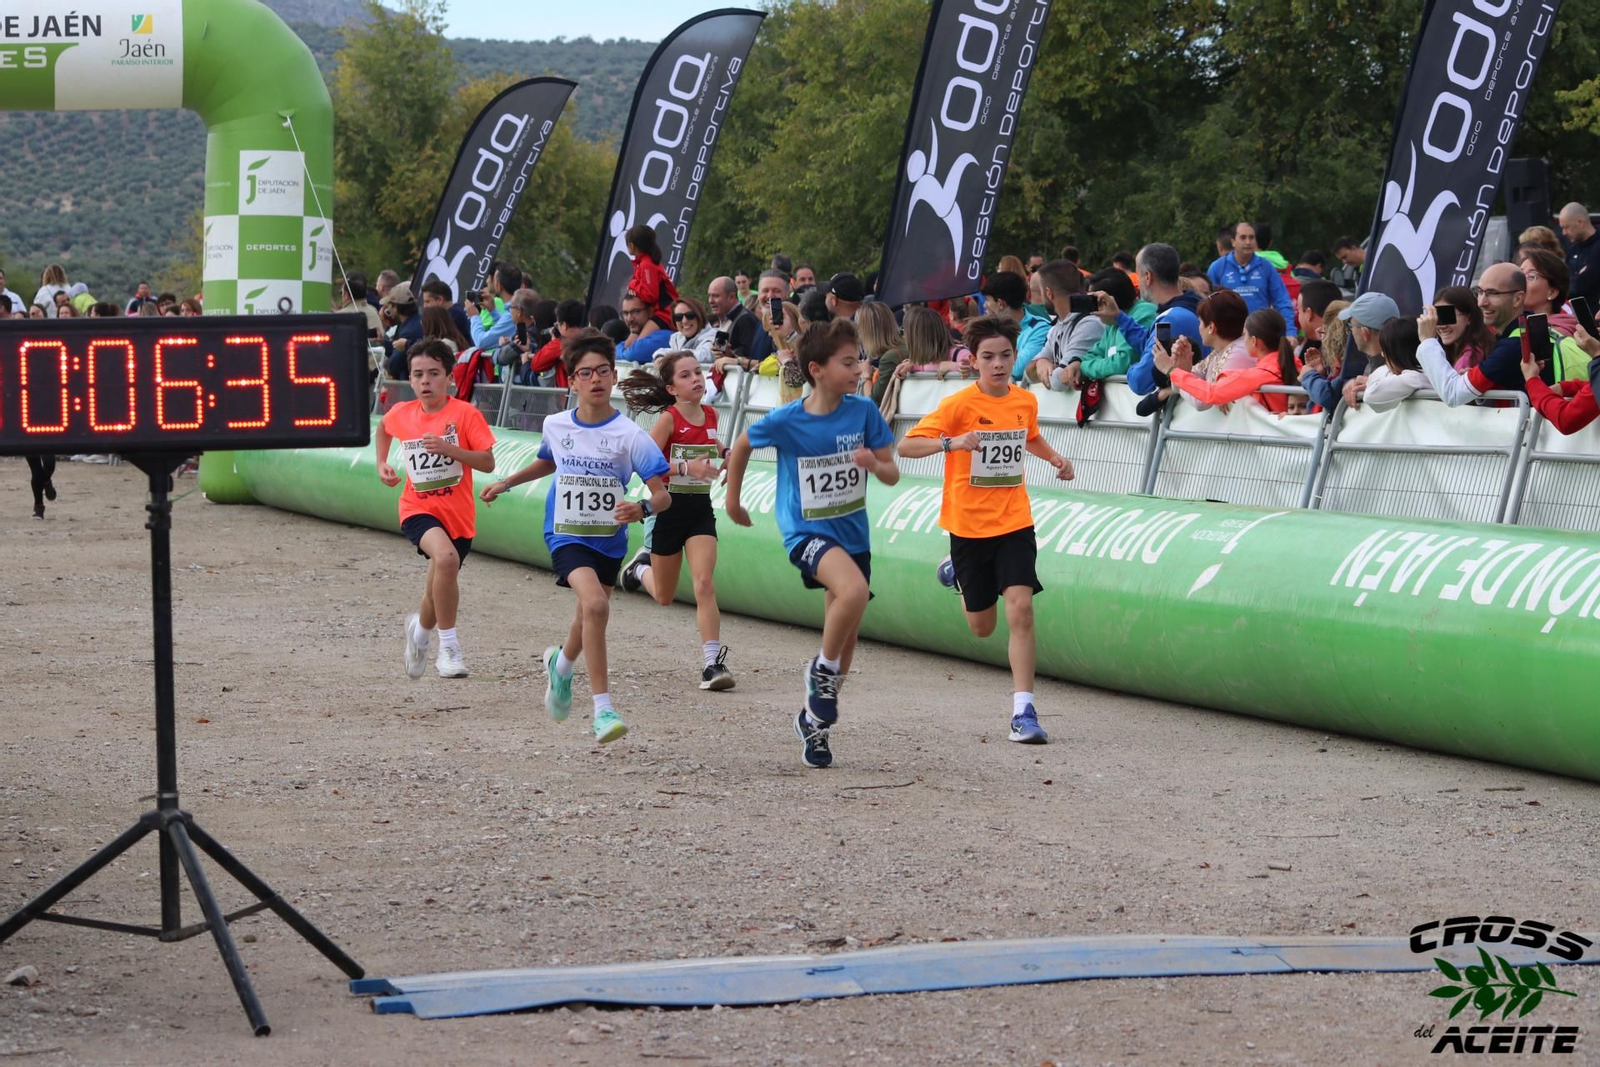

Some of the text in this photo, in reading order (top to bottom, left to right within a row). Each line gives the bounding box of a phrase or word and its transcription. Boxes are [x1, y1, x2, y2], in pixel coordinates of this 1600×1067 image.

[0, 10, 102, 38] E JAÉN
[0, 47, 47, 69] ES
[111, 58, 174, 66] PARAÍSO INTERIOR
[119, 39, 166, 59] Jaén
[940, 0, 1011, 132] od
[1466, 120, 1482, 156] ocio
[666, 206, 692, 282] stión
[1450, 184, 1495, 287] stión
[471, 242, 497, 292] tión
[0, 333, 337, 434] 0:06:35
[408, 452, 455, 471] 1225
[561, 457, 614, 470] MARACENA
[981, 444, 1023, 464] 1296
[805, 467, 860, 494] 1259
[562, 490, 616, 512] 1139
[1329, 529, 1480, 608] JAÉN
[1438, 539, 1545, 605] DE
